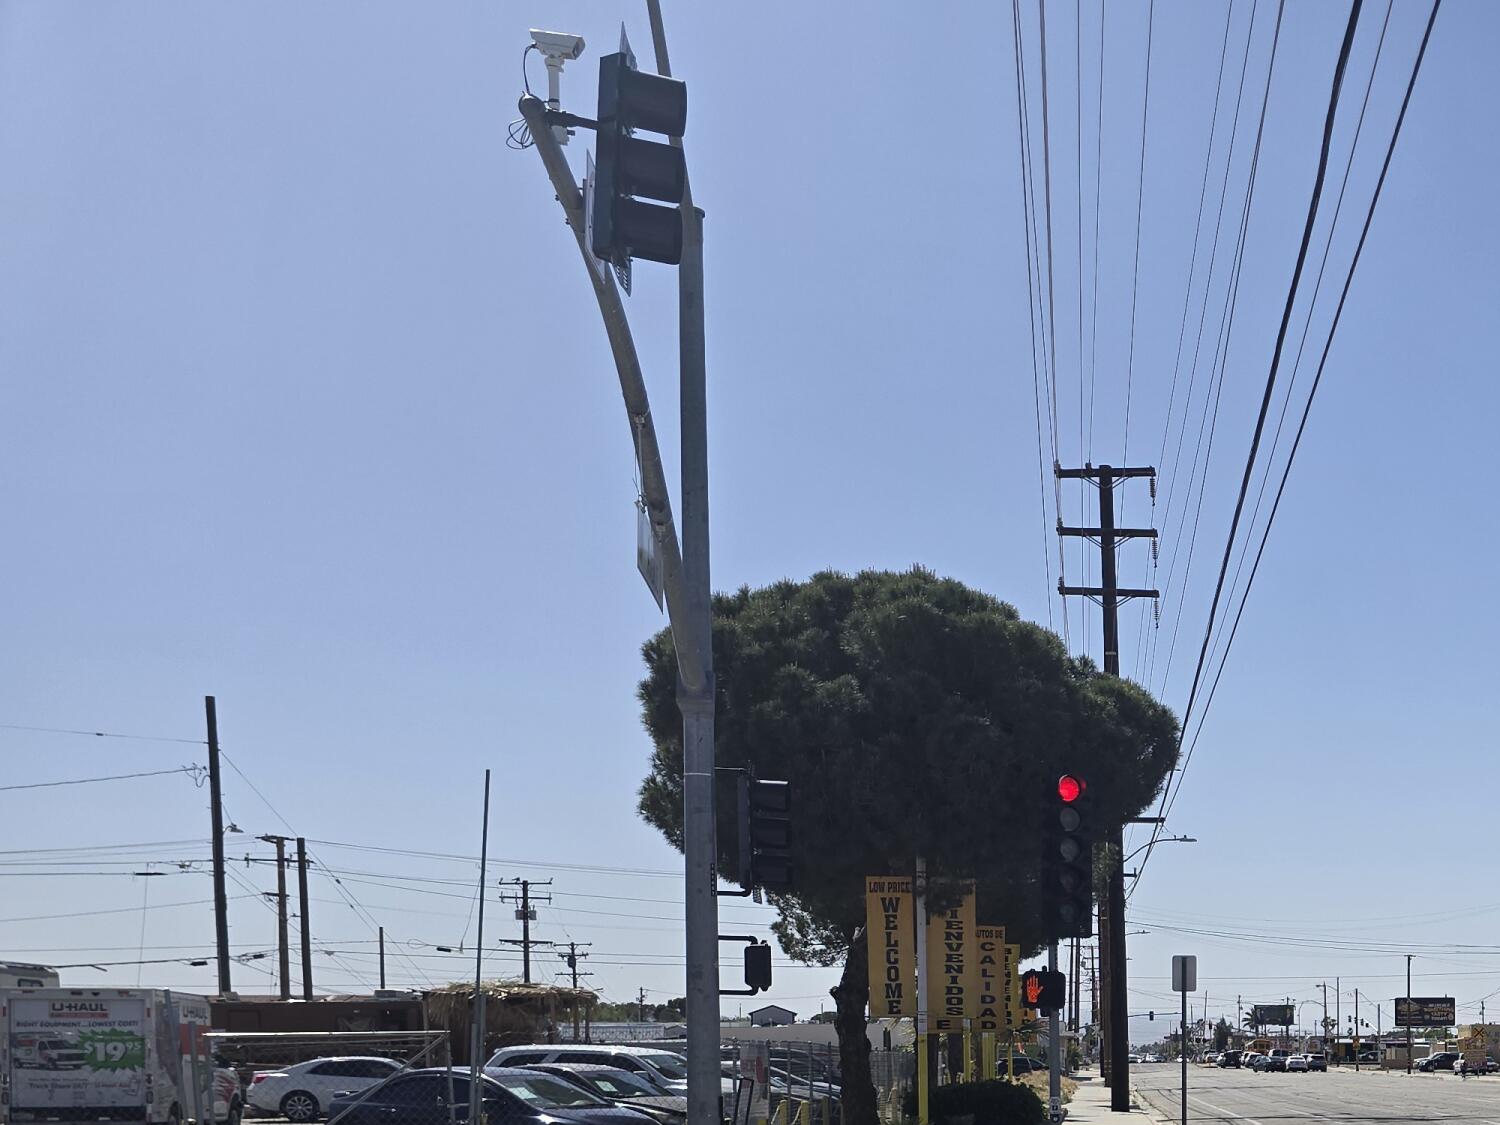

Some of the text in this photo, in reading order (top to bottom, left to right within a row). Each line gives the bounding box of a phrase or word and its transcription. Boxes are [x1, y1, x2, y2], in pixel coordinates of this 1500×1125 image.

[869, 881, 886, 894] LOW
[880, 897, 903, 1015] WELCOME
[976, 929, 994, 939] UTOS
[943, 904, 964, 1017] IENVENIDOS
[979, 941, 997, 1030] CALIDAD
[51, 1002, 108, 1012] U-HAUL
